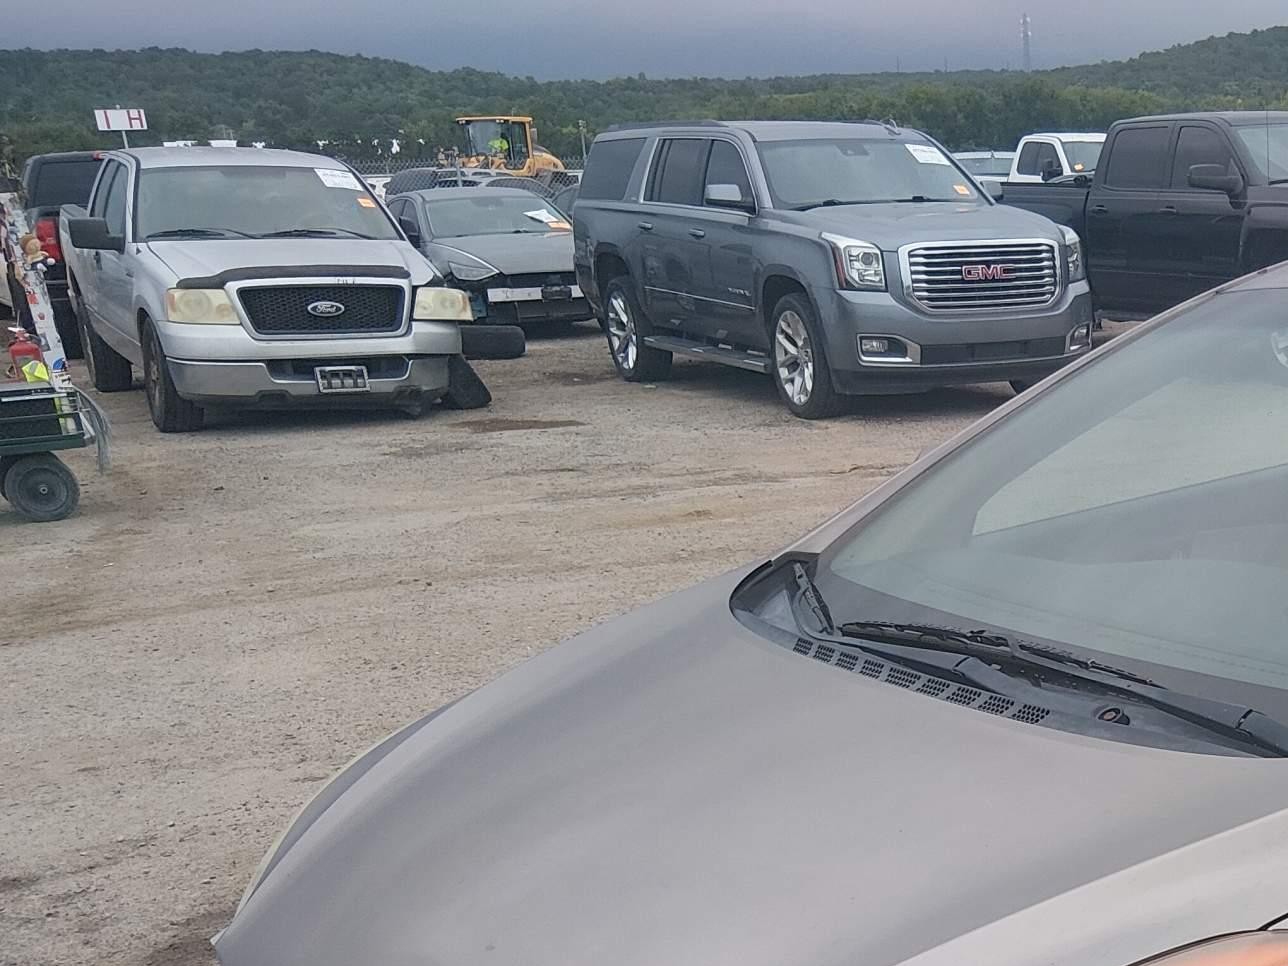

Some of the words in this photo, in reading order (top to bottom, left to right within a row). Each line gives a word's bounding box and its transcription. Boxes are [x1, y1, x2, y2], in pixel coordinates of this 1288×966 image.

[127, 110, 144, 129] H
[962, 264, 1016, 280] GMC
[316, 304, 336, 313] Ford
